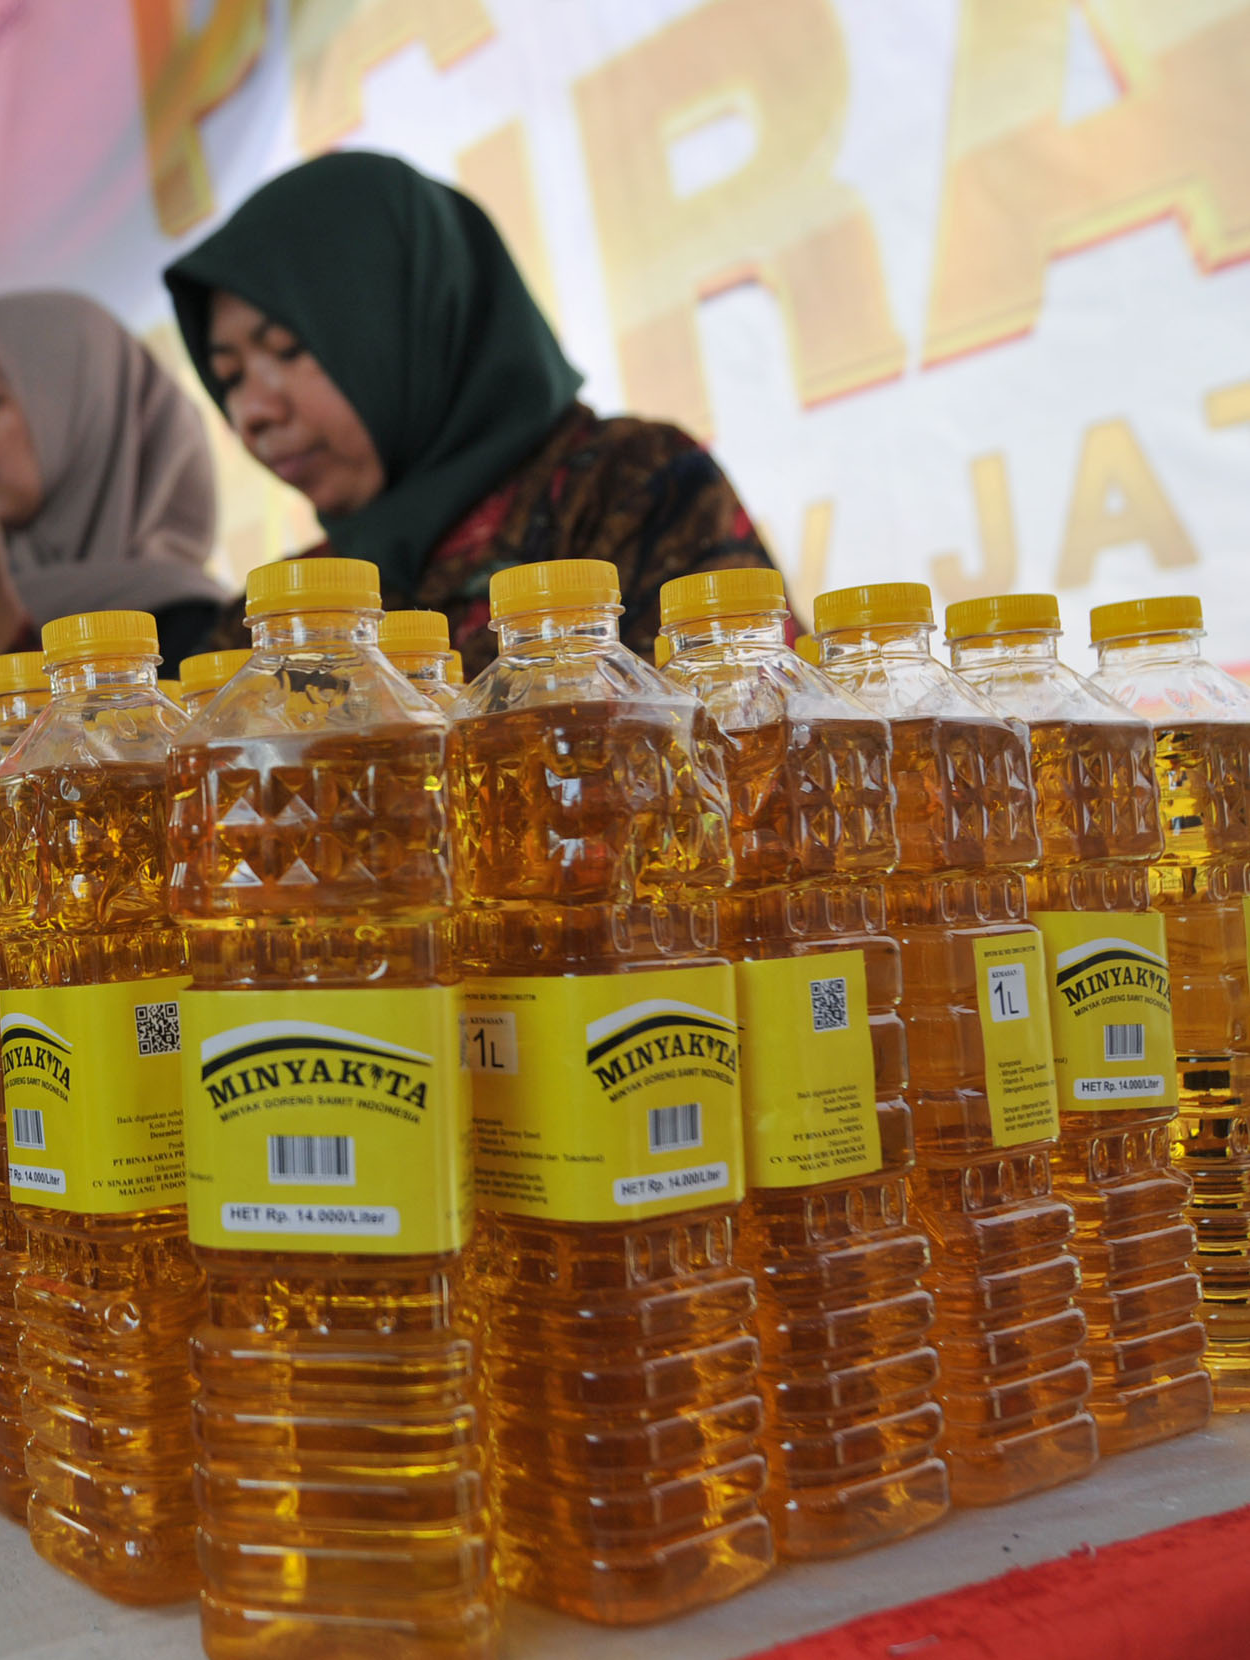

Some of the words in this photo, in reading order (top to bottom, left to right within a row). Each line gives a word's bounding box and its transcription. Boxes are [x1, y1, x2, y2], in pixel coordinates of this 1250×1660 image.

[206, 1058, 429, 1111] MINYAKITA
[1082, 1082, 1101, 1091] HET
[1104, 1081, 1117, 1093] Rp.
[1119, 1079, 1158, 1089] 14.000/Liter
[113, 1159, 124, 1167] PT
[14, 1169, 23, 1183] Rp.
[25, 1171, 60, 1185] 14.000/Liter
[93, 1180, 103, 1188] CV
[108, 1178, 134, 1187] SINAR
[119, 1186, 155, 1195] MALANG
[230, 1207, 260, 1221] HET
[266, 1208, 288, 1223] Rp.
[297, 1209, 384, 1224] 14.000/Liter
